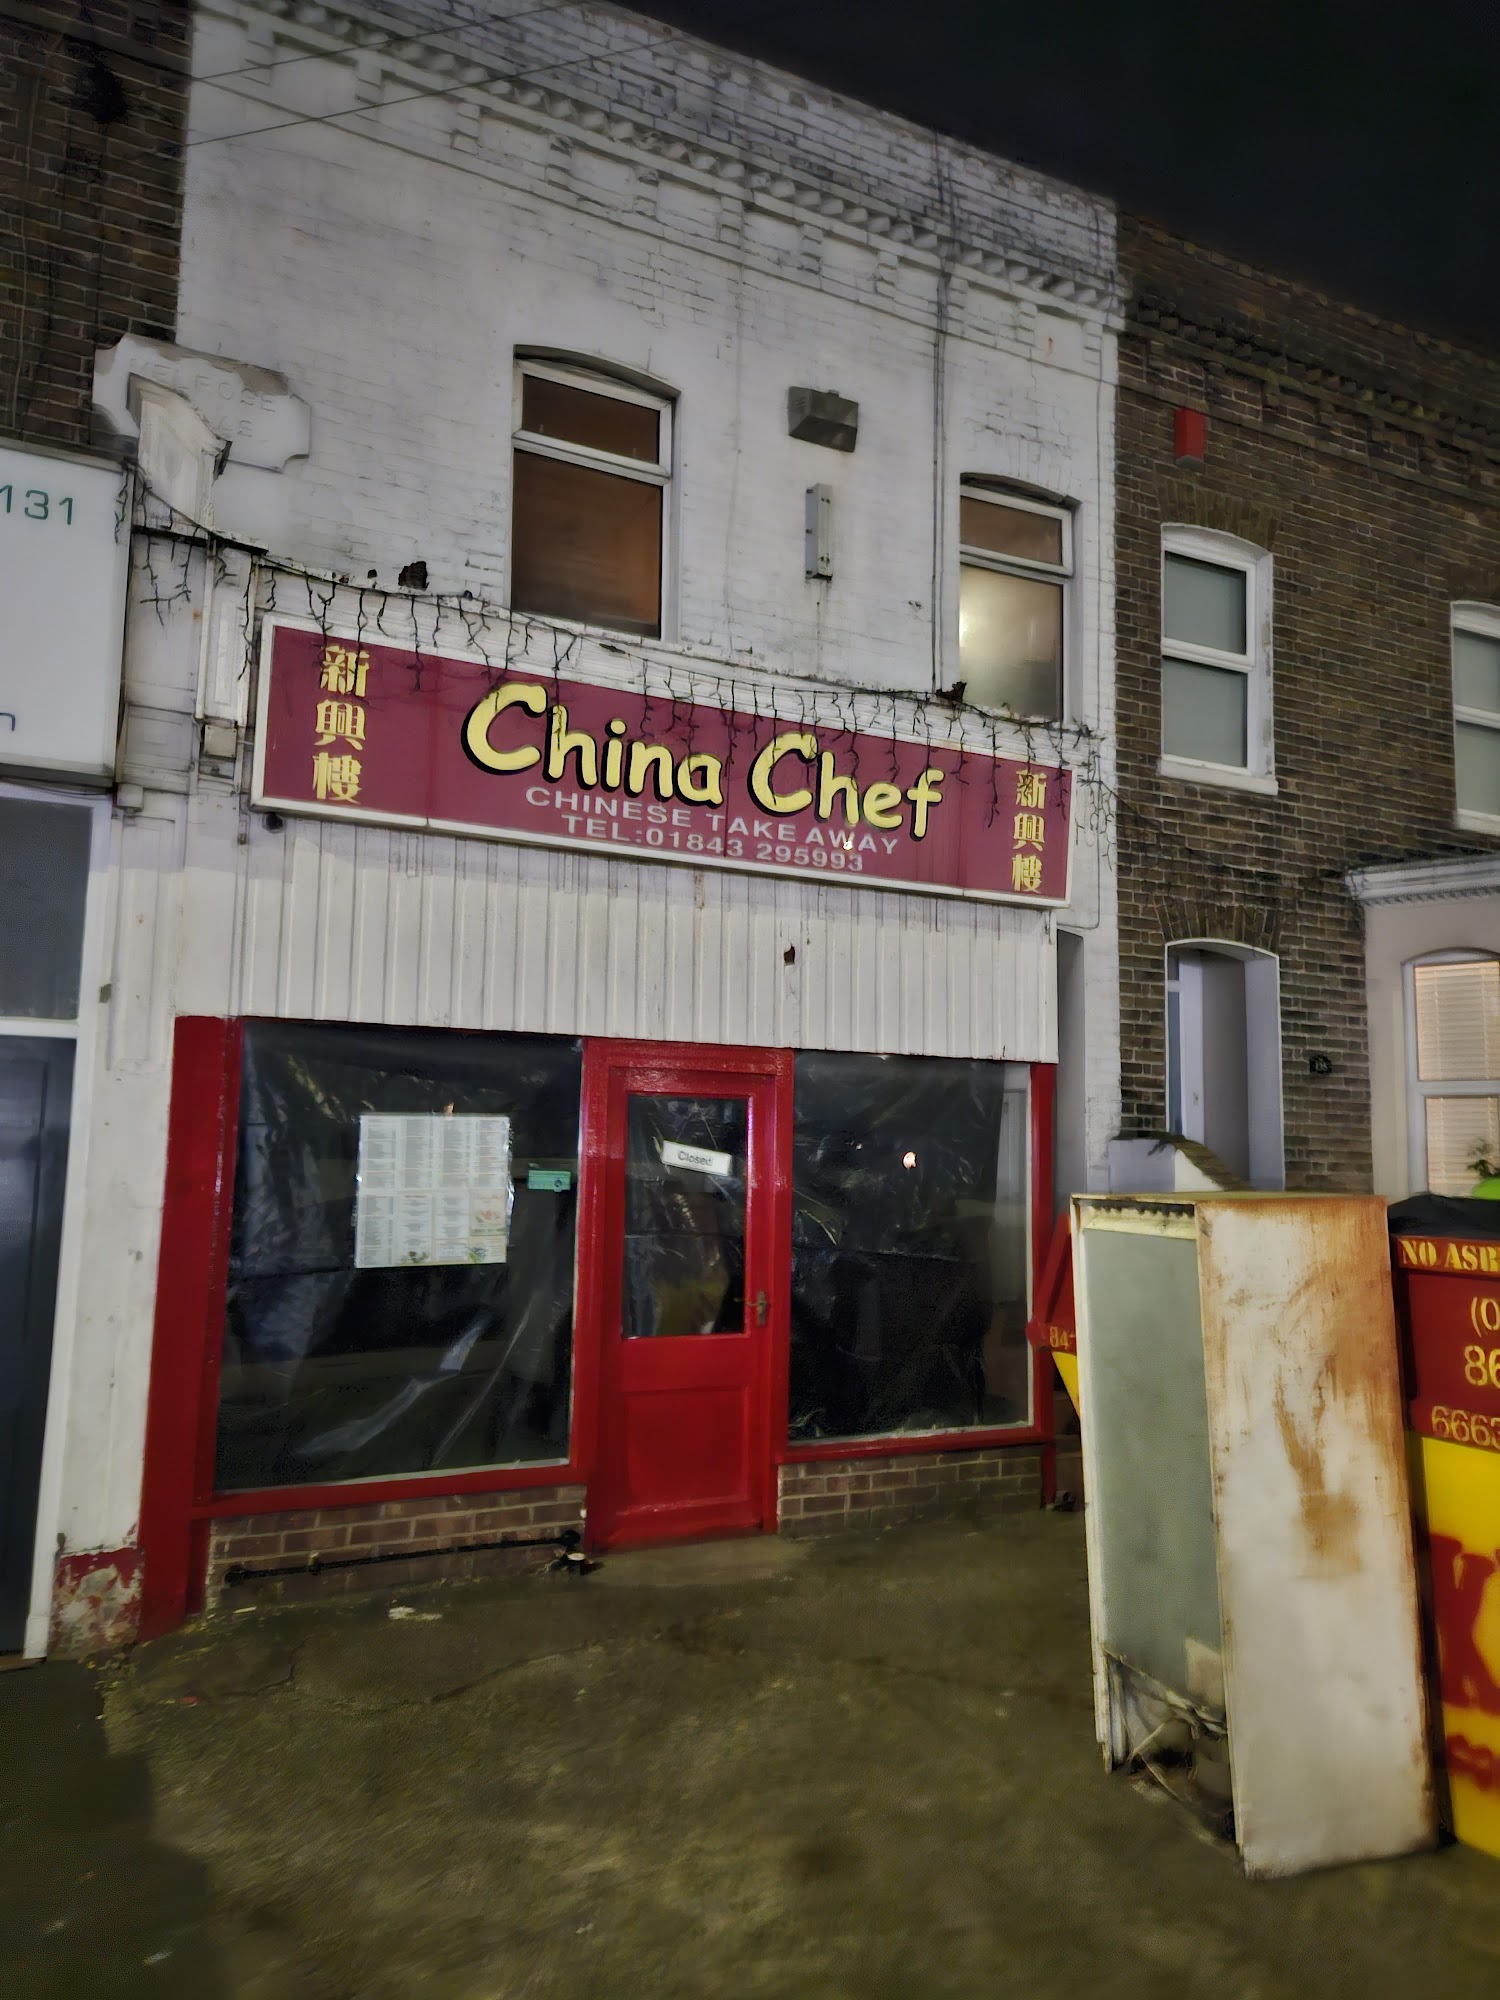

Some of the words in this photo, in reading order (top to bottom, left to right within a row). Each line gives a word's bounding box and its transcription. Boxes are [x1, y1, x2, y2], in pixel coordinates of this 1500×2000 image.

[312, 645, 370, 804] 新興樓
[463, 682, 724, 806] China
[750, 732, 945, 839] Chef
[525, 786, 692, 829] CHINESE
[706, 813, 797, 842] TAKE
[805, 827, 898, 855] AWAY
[561, 814, 743, 857] TEL:01843
[756, 843, 863, 872] 295993
[677, 1151, 713, 1166] Closed
[1400, 1240, 1437, 1267] NO
